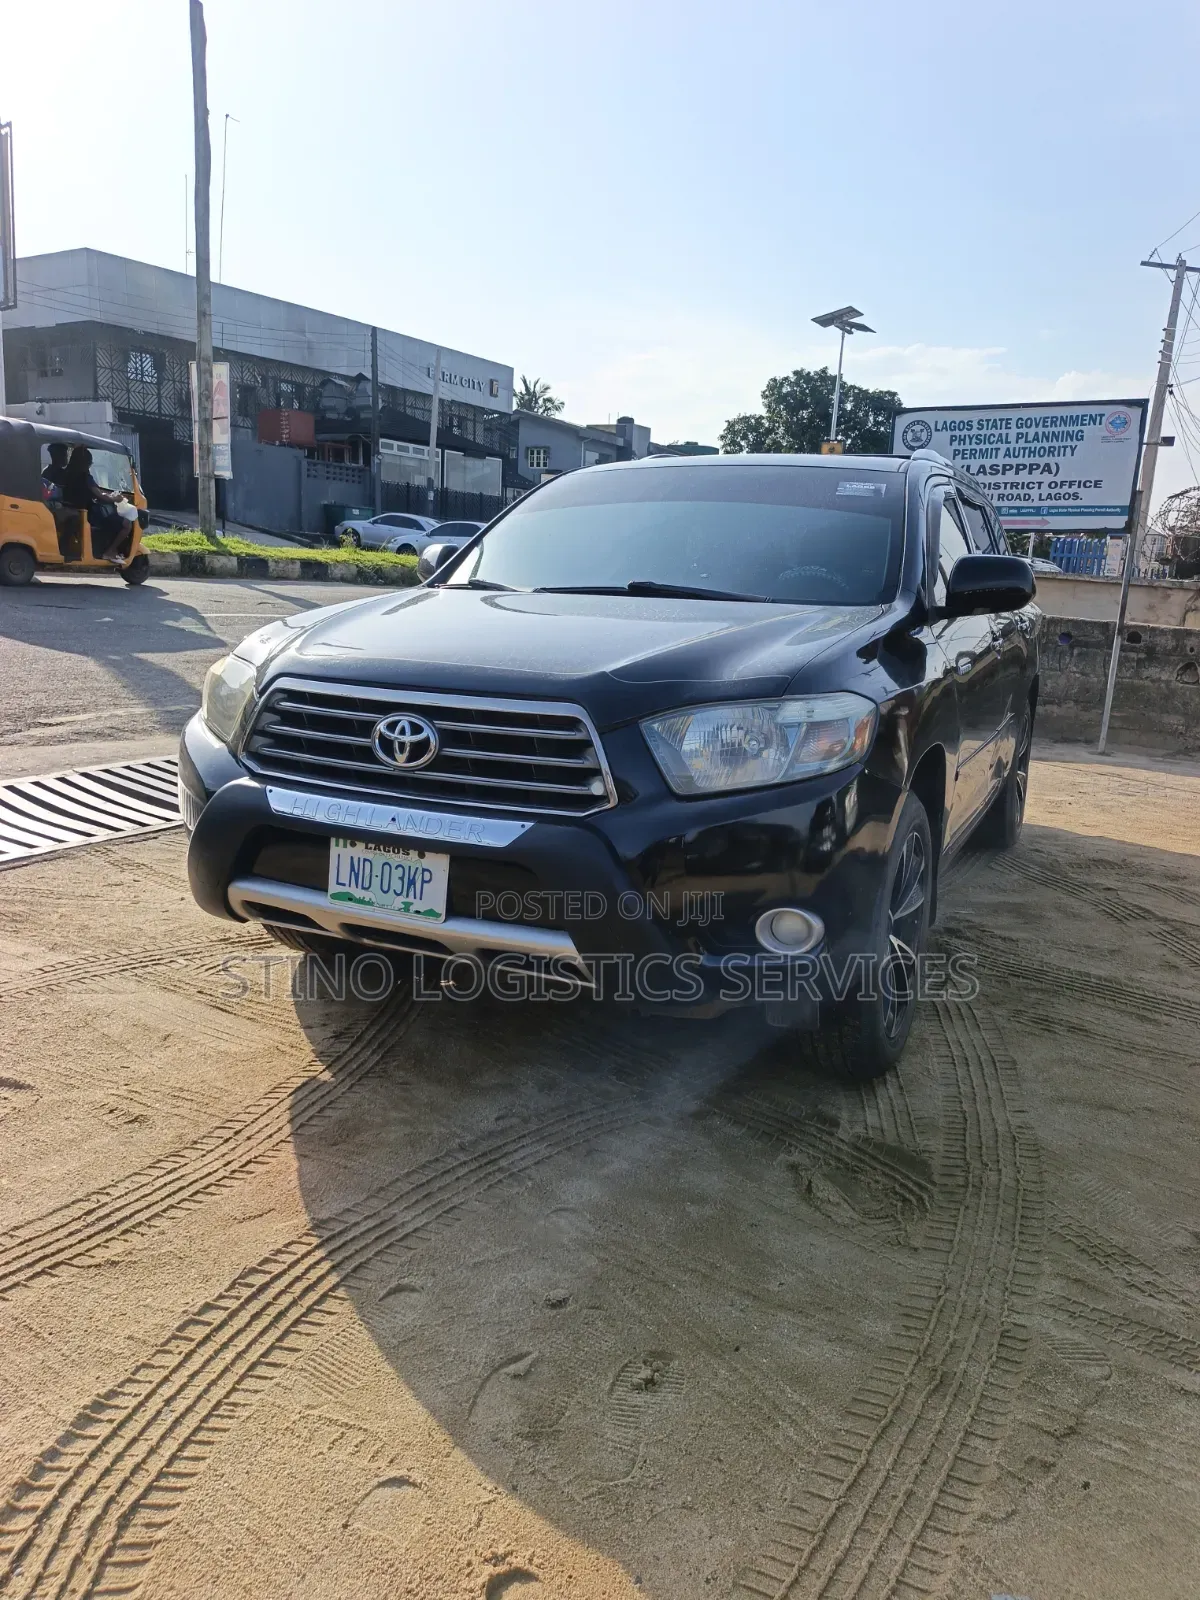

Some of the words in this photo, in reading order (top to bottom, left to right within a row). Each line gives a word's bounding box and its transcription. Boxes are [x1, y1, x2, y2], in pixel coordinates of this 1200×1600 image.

[461, 376, 486, 392] CITY
[934, 420, 973, 432] LAGOS
[976, 418, 1012, 431] STATE
[1015, 413, 1105, 429] GOVERNMENT
[949, 433, 1011, 446] PHYSICAL
[1015, 429, 1085, 444] PLANNING
[952, 447, 1001, 460] PERMIT
[1003, 445, 1078, 459] AUTHORITY
[1048, 480, 1103, 490] OFFICE
[997, 493, 1034, 503] ROAD,
[1039, 492, 1083, 501] LAGOS.
[290, 797, 485, 843] HIGHLANDER
[365, 842, 411, 856] LAGOS
